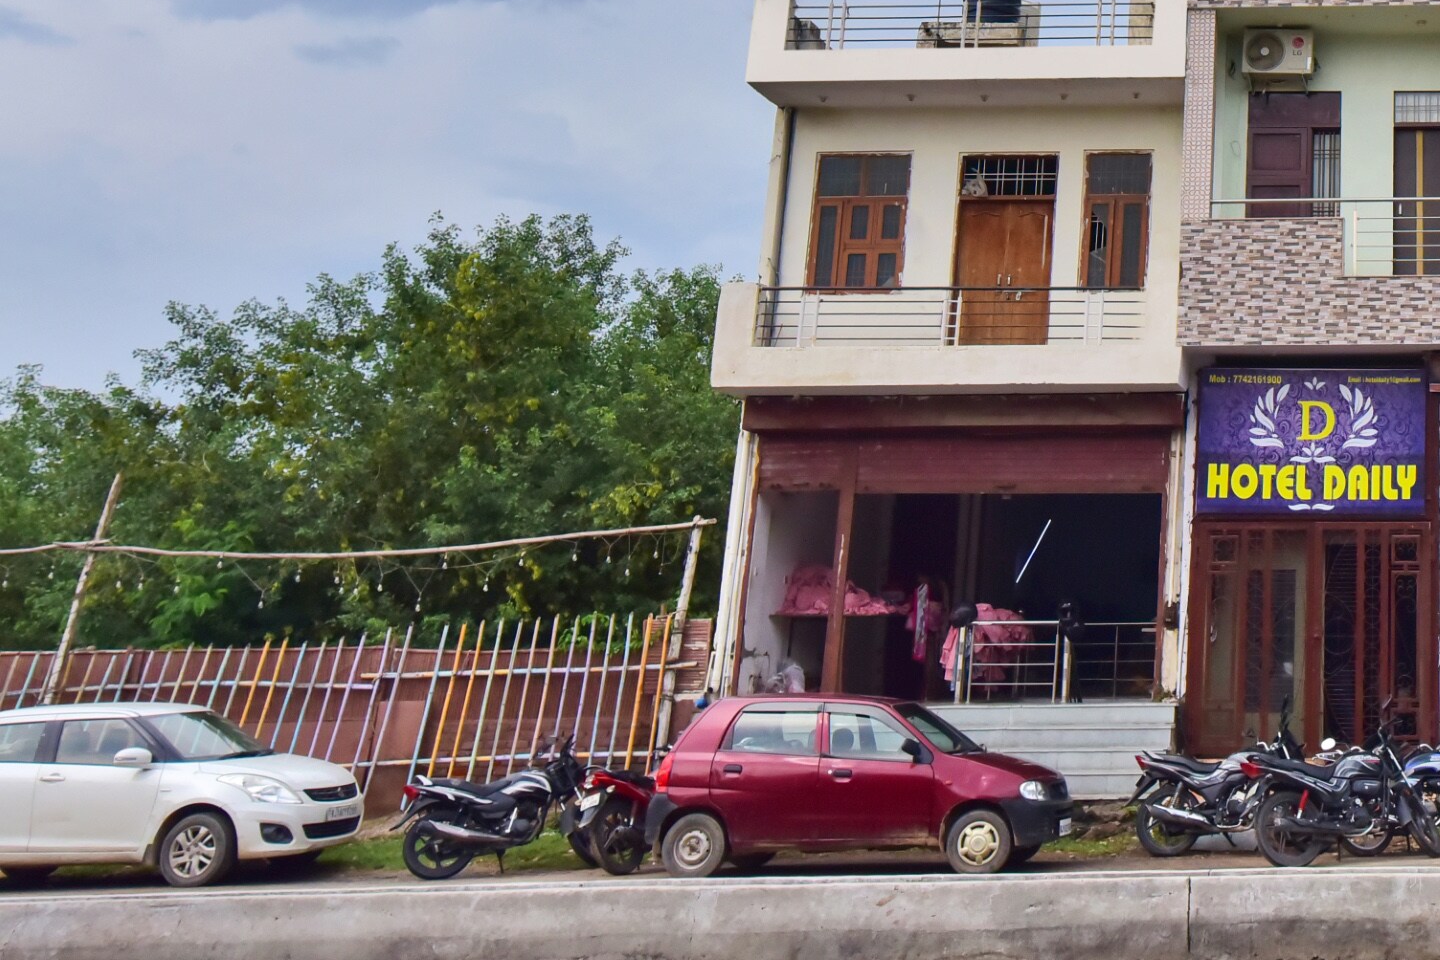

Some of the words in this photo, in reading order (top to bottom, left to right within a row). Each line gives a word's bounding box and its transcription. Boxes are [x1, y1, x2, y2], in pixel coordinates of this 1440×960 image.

[1209, 375, 1226, 384] Mob
[1233, 375, 1282, 384] 7742161900
[1296, 400, 1336, 440] D
[1207, 463, 1312, 500] HOTEL
[1323, 464, 1417, 500] DAILY
